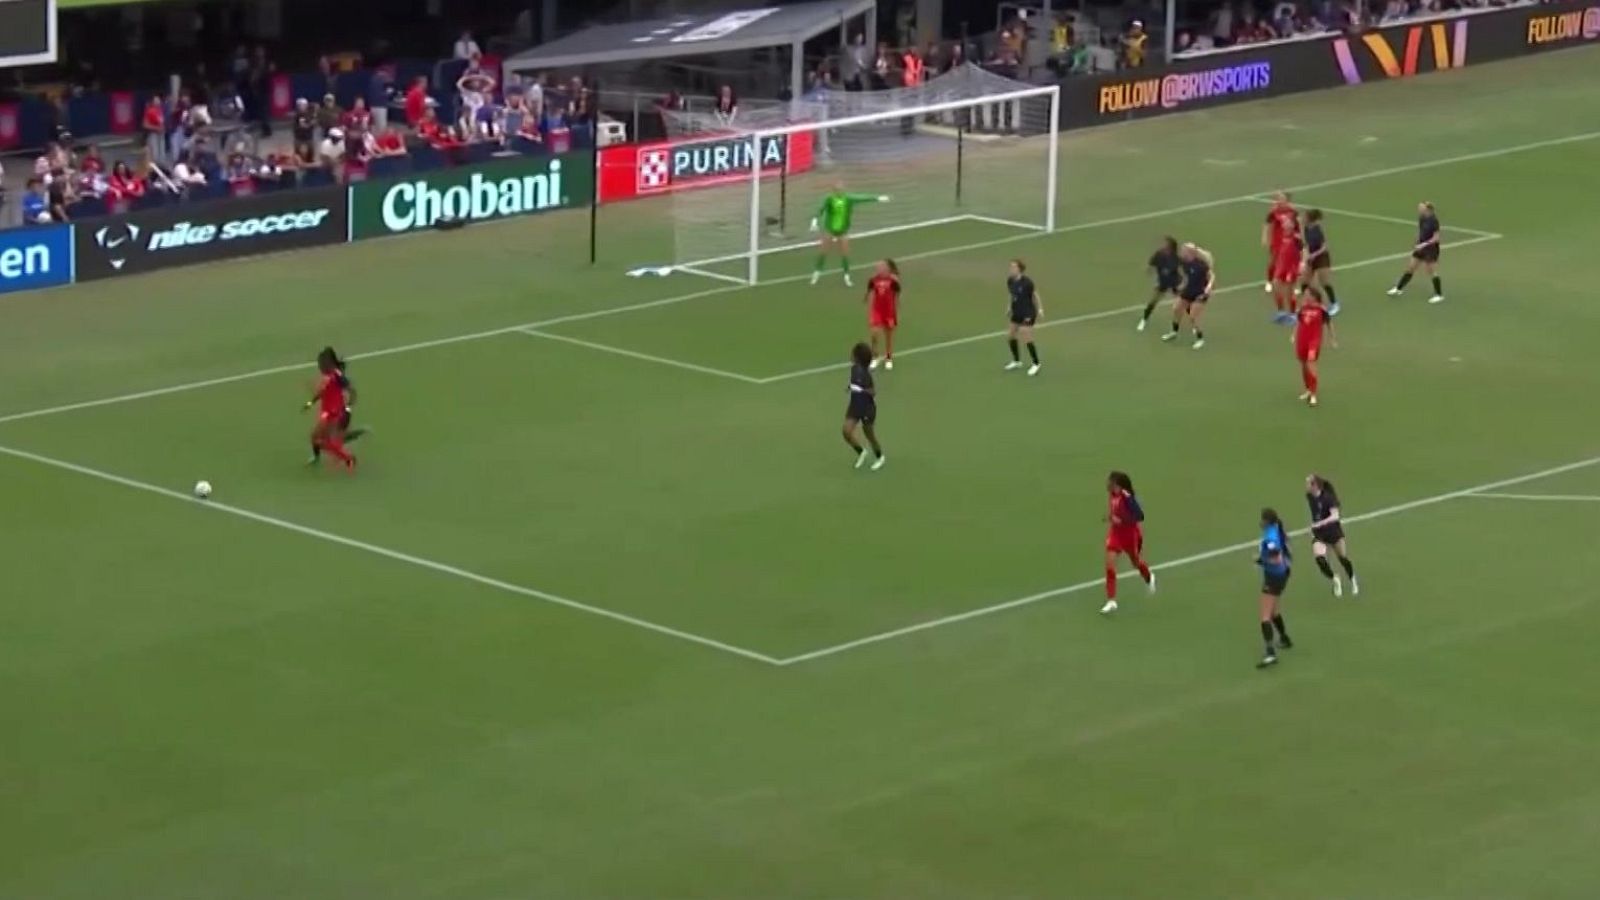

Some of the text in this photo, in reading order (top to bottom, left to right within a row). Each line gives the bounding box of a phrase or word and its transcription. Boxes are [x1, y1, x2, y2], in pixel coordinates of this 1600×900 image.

[1527, 12, 1582, 43] FOLLOW
[1099, 62, 1271, 113] FOLLOW @BRWSPORTS
[382, 158, 562, 232] Chobani
[148, 208, 330, 251] nike soccer
